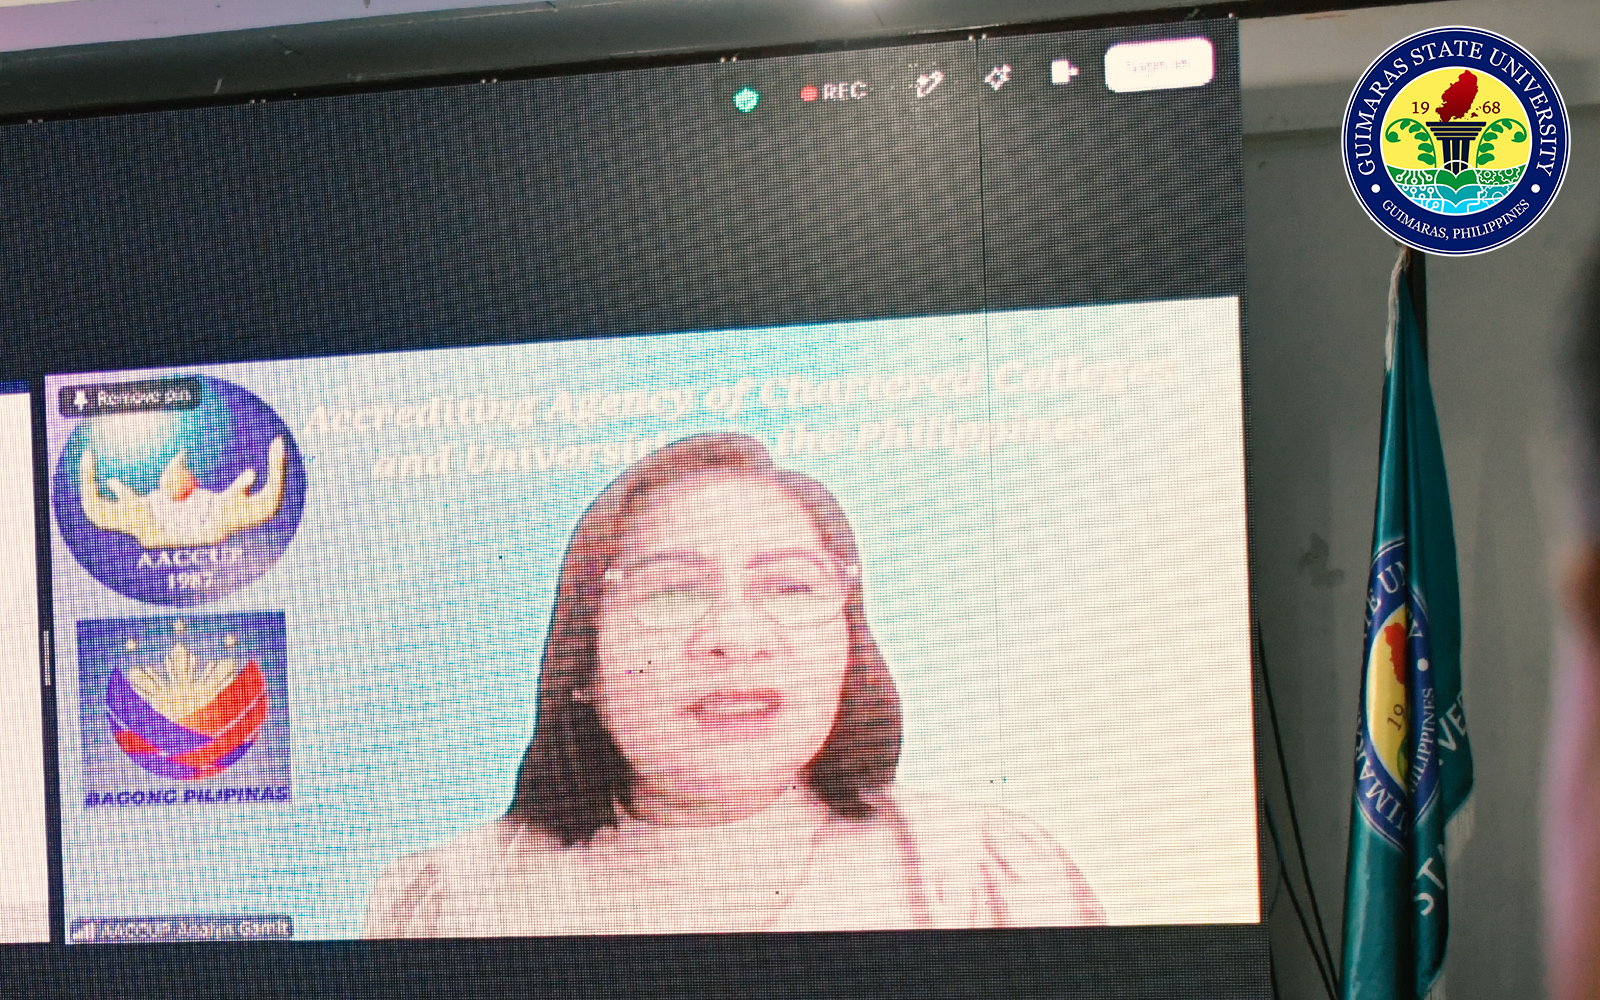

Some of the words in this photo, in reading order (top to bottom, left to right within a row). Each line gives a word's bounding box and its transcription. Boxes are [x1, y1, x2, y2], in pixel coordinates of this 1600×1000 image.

[823, 80, 868, 101] REC
[302, 397, 537, 434] Accrediting
[546, 388, 694, 428] Agency
[702, 376, 751, 423] of
[759, 362, 982, 411] Chartered
[374, 441, 452, 480] and
[465, 431, 667, 474] Universit
[777, 421, 843, 457] the
[856, 414, 1100, 457] Philippines
[84, 789, 177, 809] BAGONG
[183, 785, 291, 804] PILIPINAS
